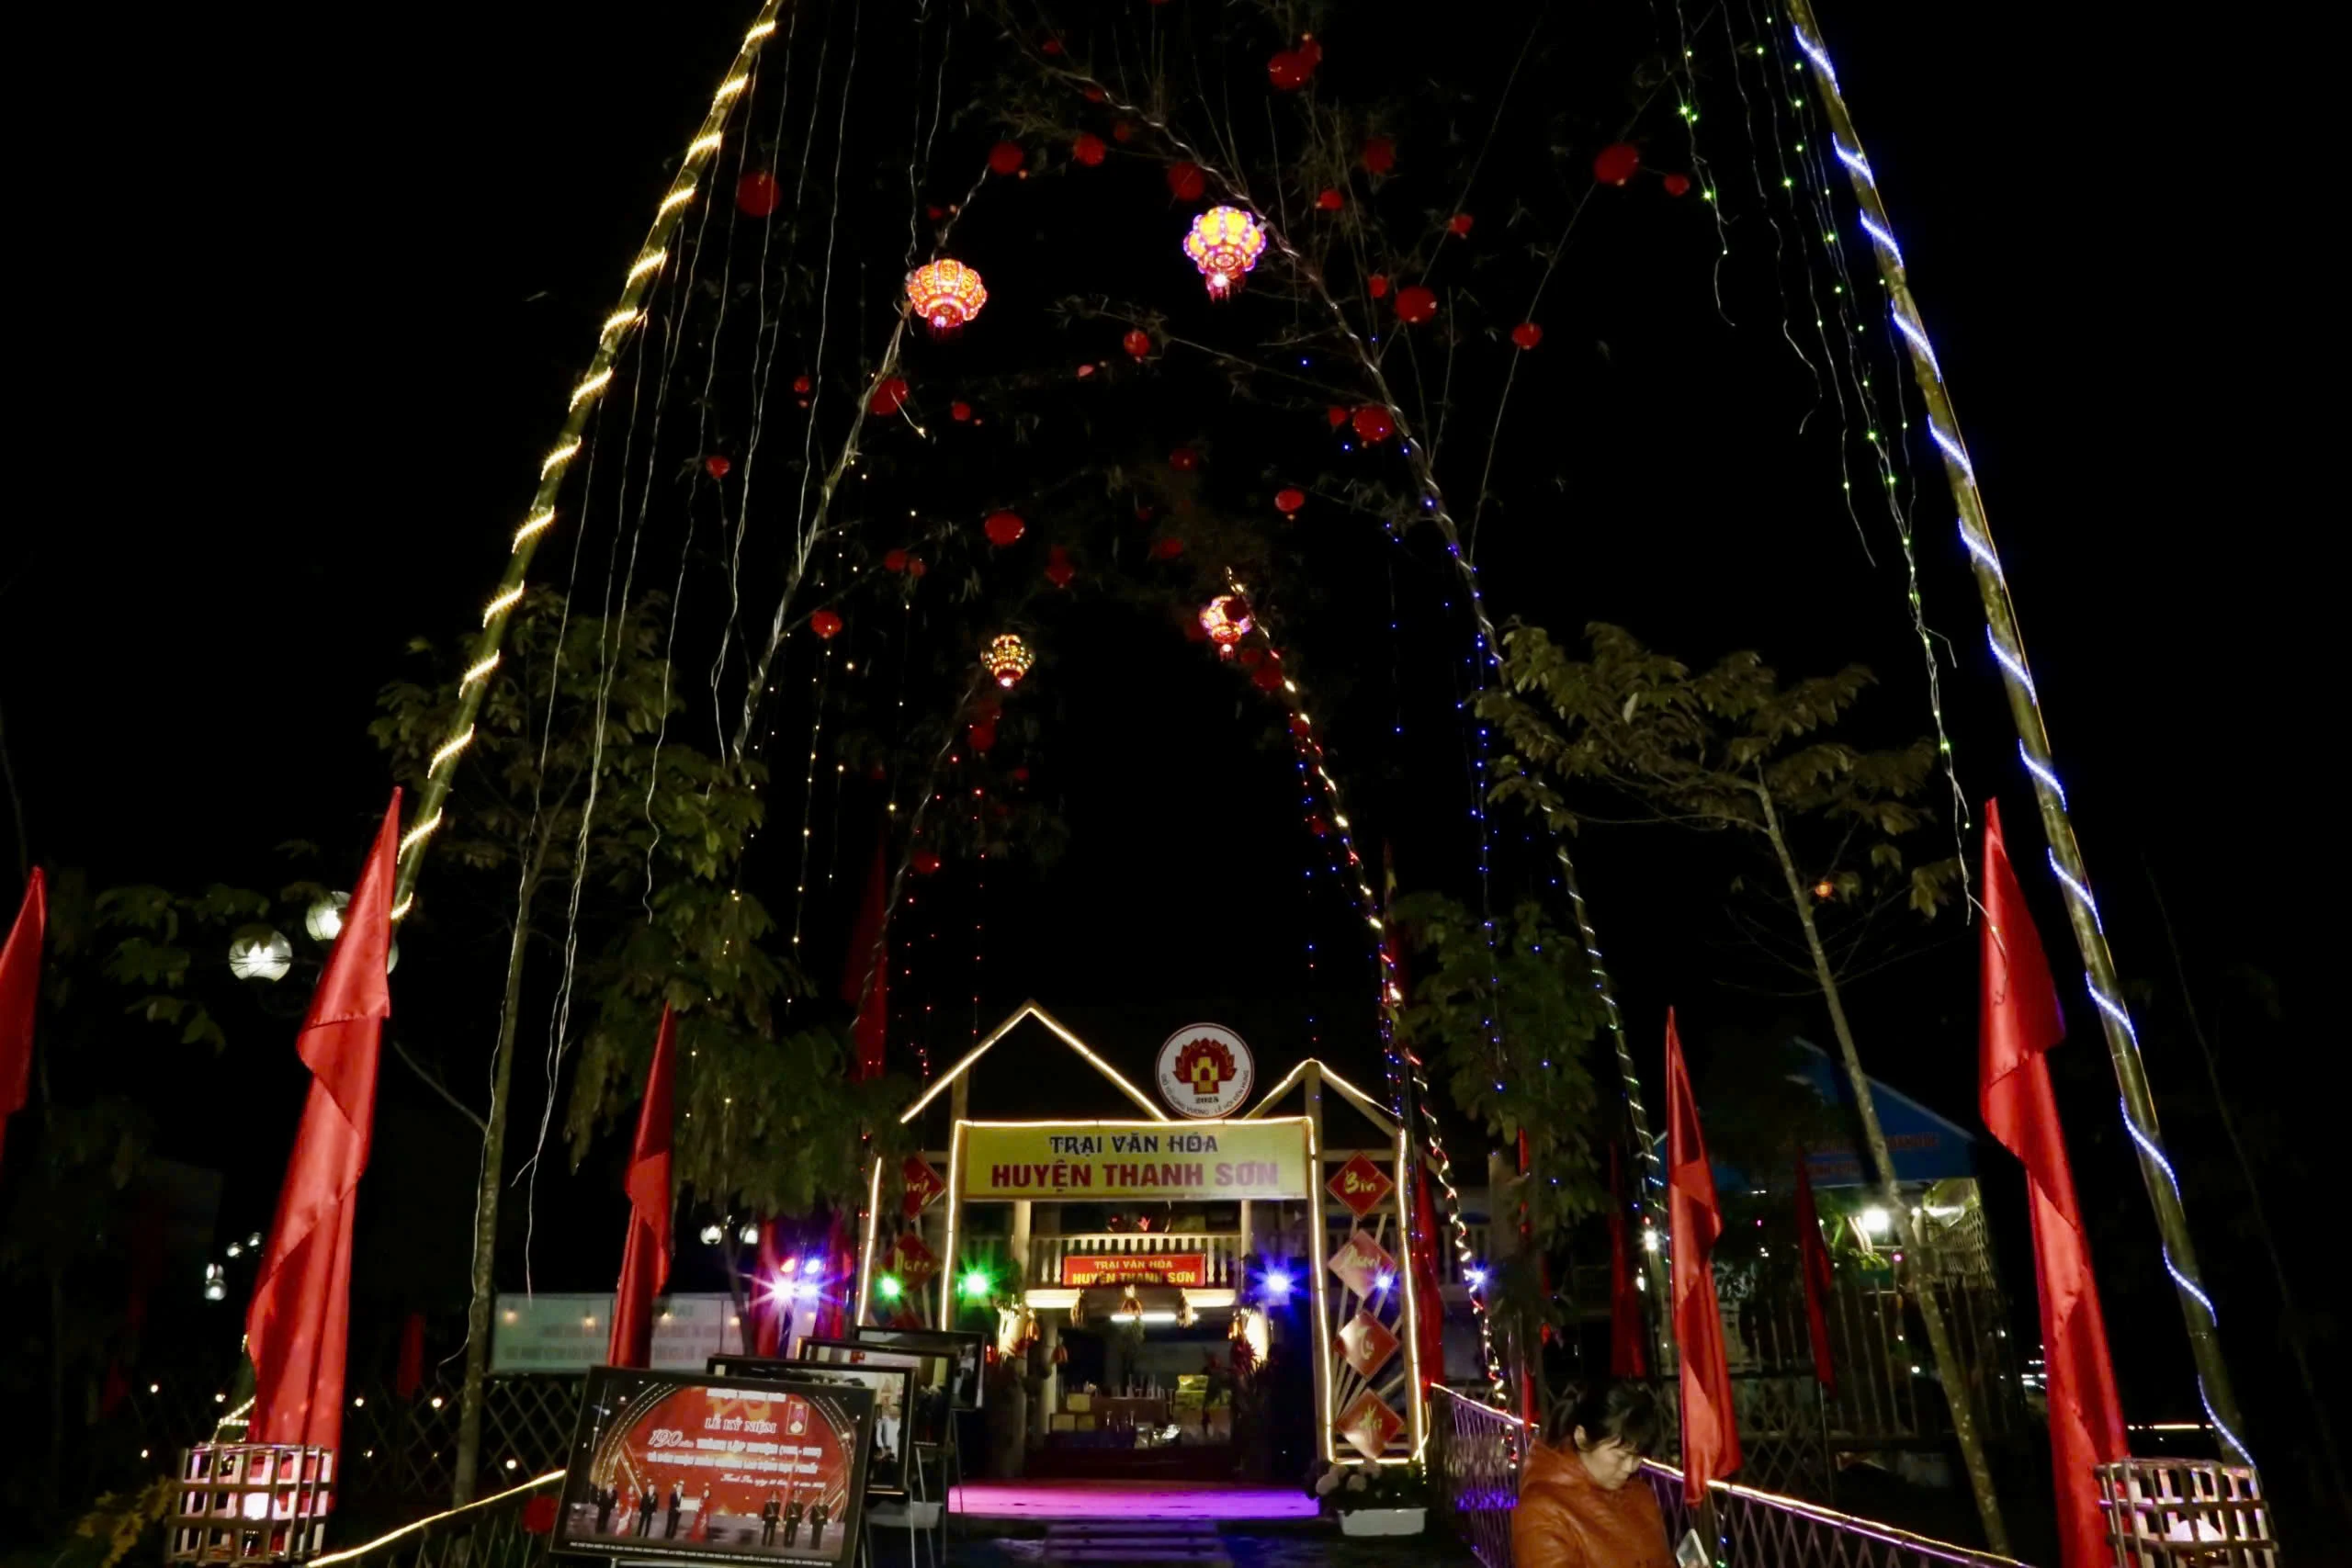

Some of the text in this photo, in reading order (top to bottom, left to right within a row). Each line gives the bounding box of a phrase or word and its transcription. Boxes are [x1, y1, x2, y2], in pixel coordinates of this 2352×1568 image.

[1049, 1131, 1218, 1156] TRẠI VĂN HÓA
[991, 1159, 1279, 1191] HUYỆN THANH SƠN
[1168, 1270, 1195, 1283] SƠN
[648, 1429, 684, 1448] 190
